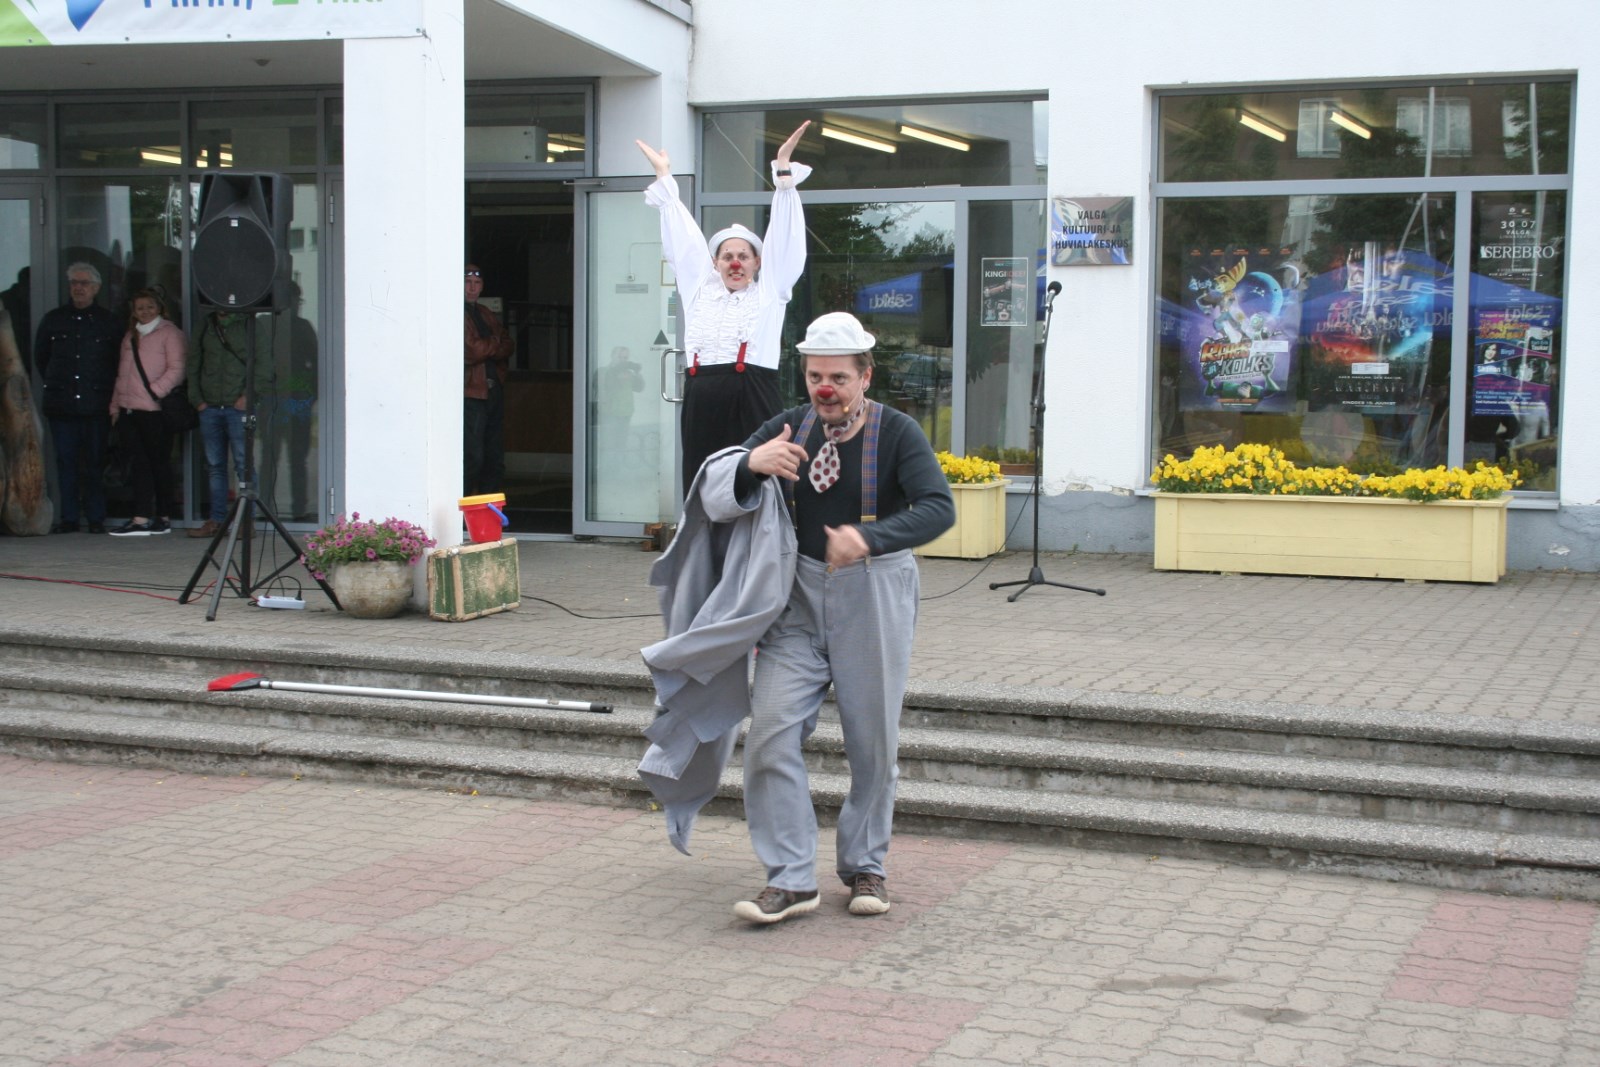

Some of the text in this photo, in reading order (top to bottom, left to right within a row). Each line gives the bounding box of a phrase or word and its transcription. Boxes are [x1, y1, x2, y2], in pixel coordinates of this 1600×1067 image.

[1077, 210, 1106, 220] VALGA
[1055, 239, 1129, 249] HUVIALAKESKUS
[1485, 245, 1555, 259] SEREBRO
[1220, 352, 1276, 376] KOLKS
